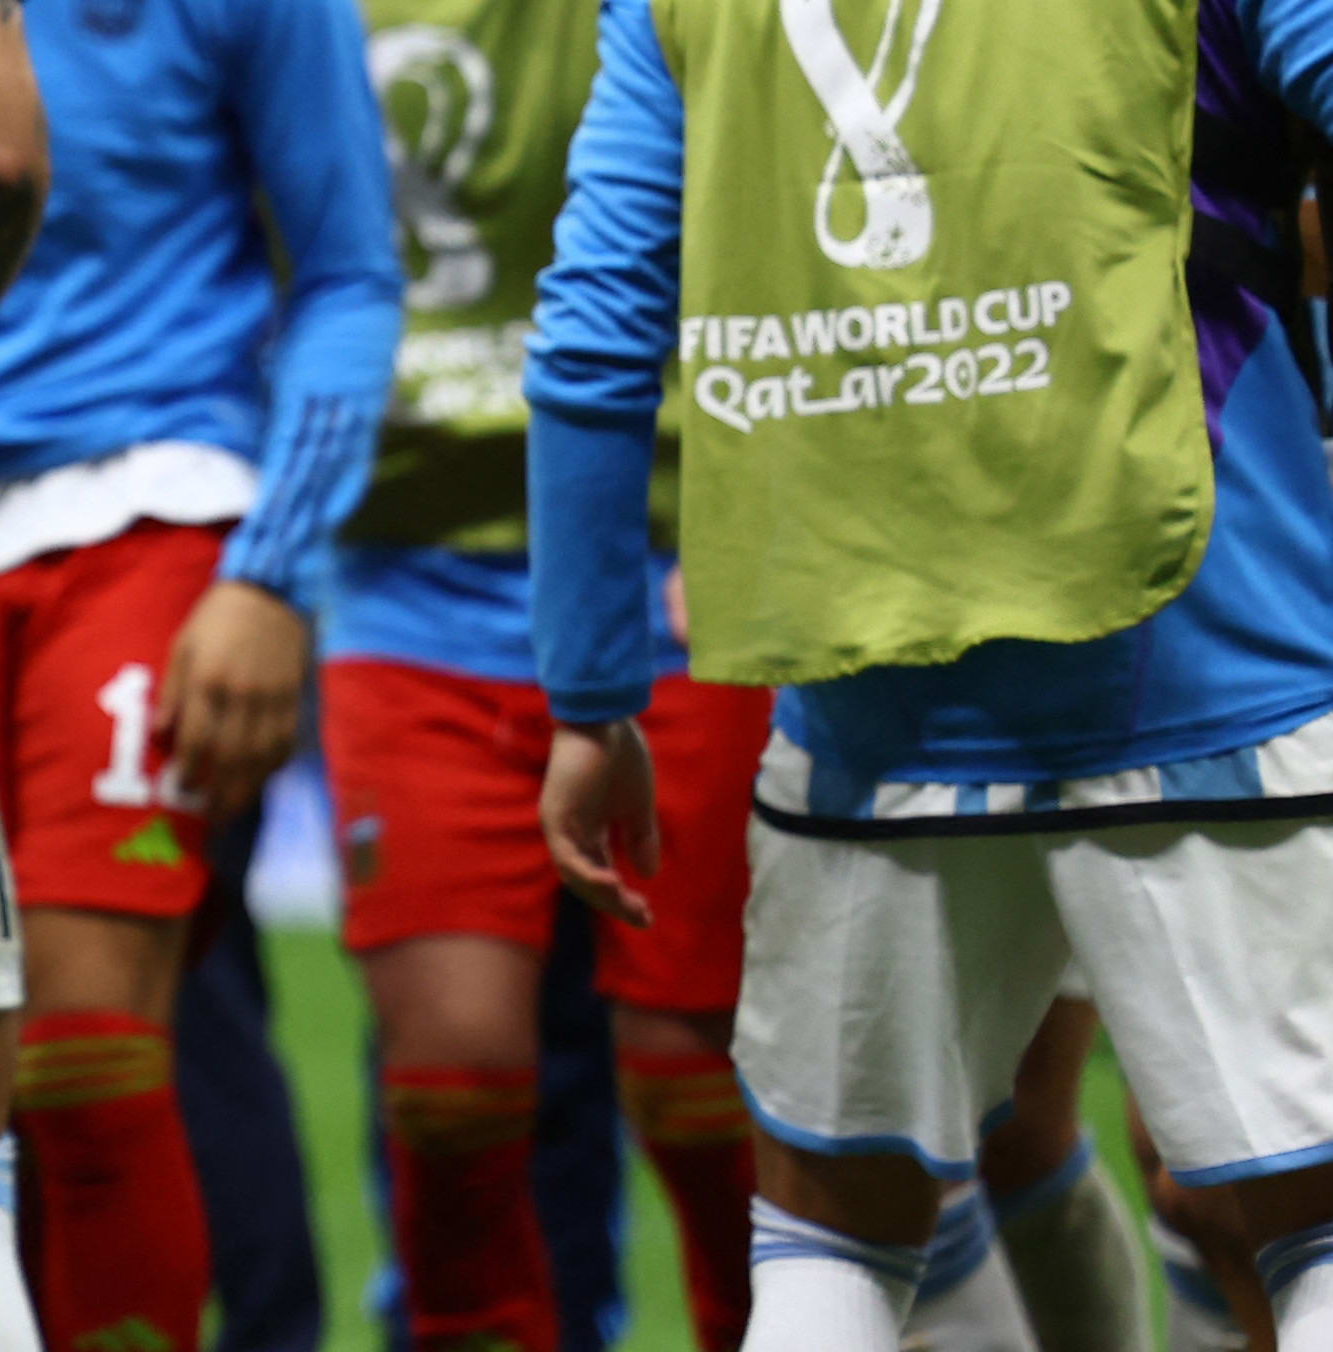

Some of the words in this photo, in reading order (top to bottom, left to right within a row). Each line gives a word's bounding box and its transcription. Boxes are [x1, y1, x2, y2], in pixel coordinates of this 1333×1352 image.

[679, 315, 791, 363] FIFA
[790, 296, 970, 357] WORLD
[972, 280, 1073, 336] CUP
[694, 362, 906, 435] Qatar
[903, 337, 1052, 405] 2022
